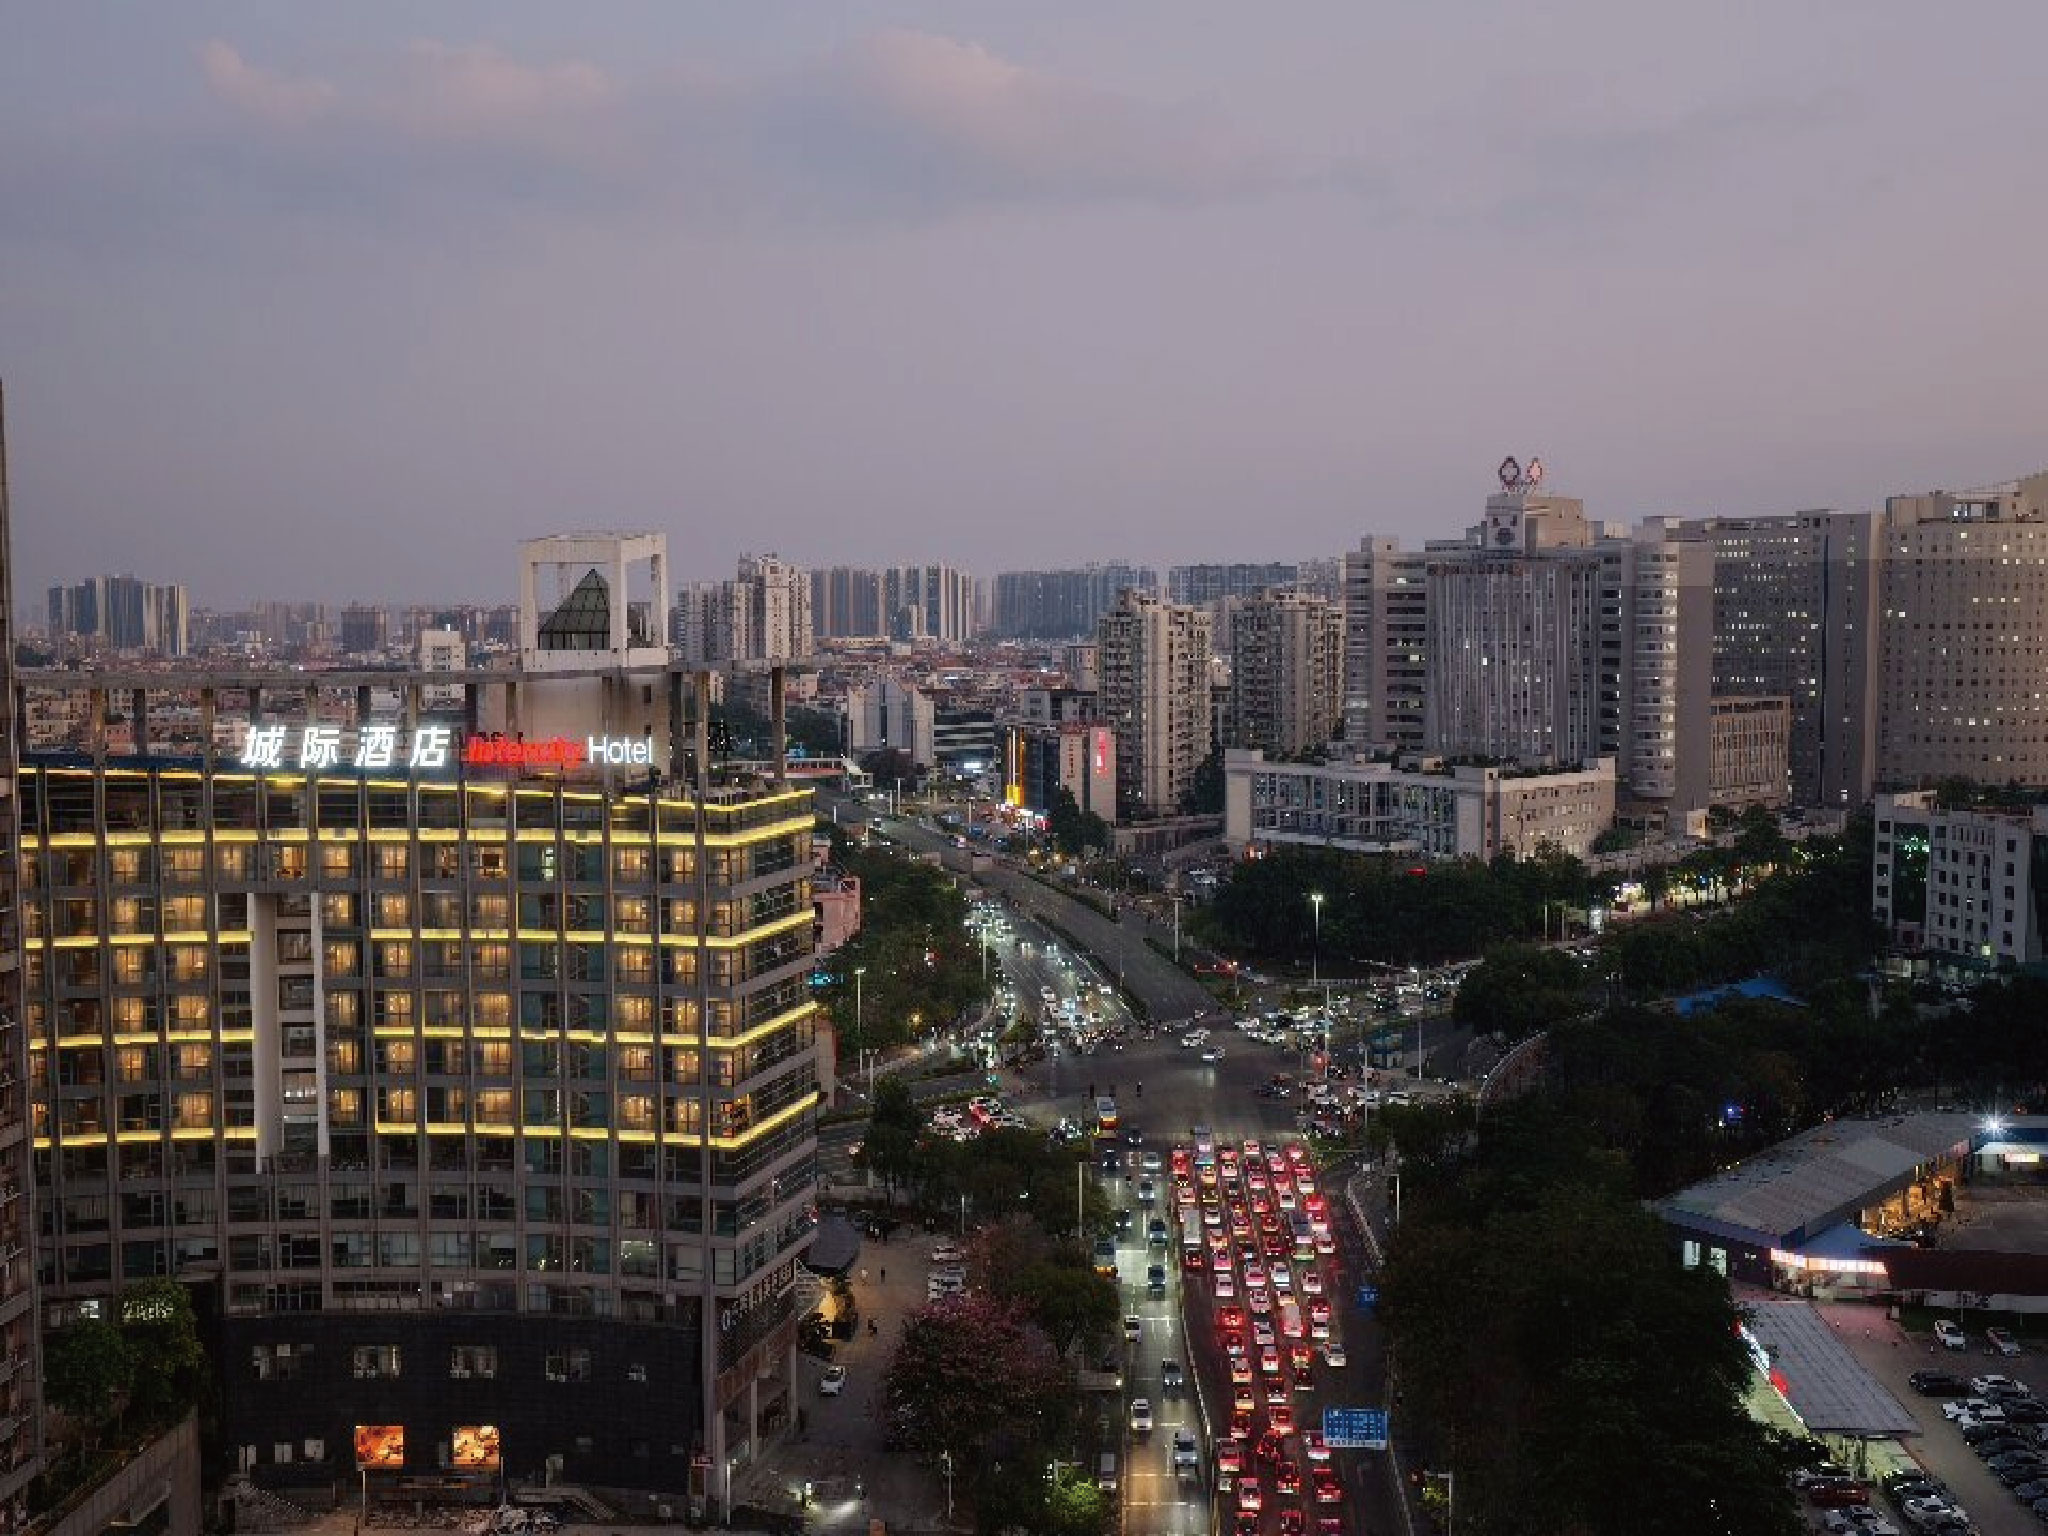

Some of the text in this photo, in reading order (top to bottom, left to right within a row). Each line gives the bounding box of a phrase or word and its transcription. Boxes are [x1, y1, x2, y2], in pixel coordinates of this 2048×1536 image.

[241, 725, 451, 768] 城际酒店
[588, 736, 653, 764] Hotel
